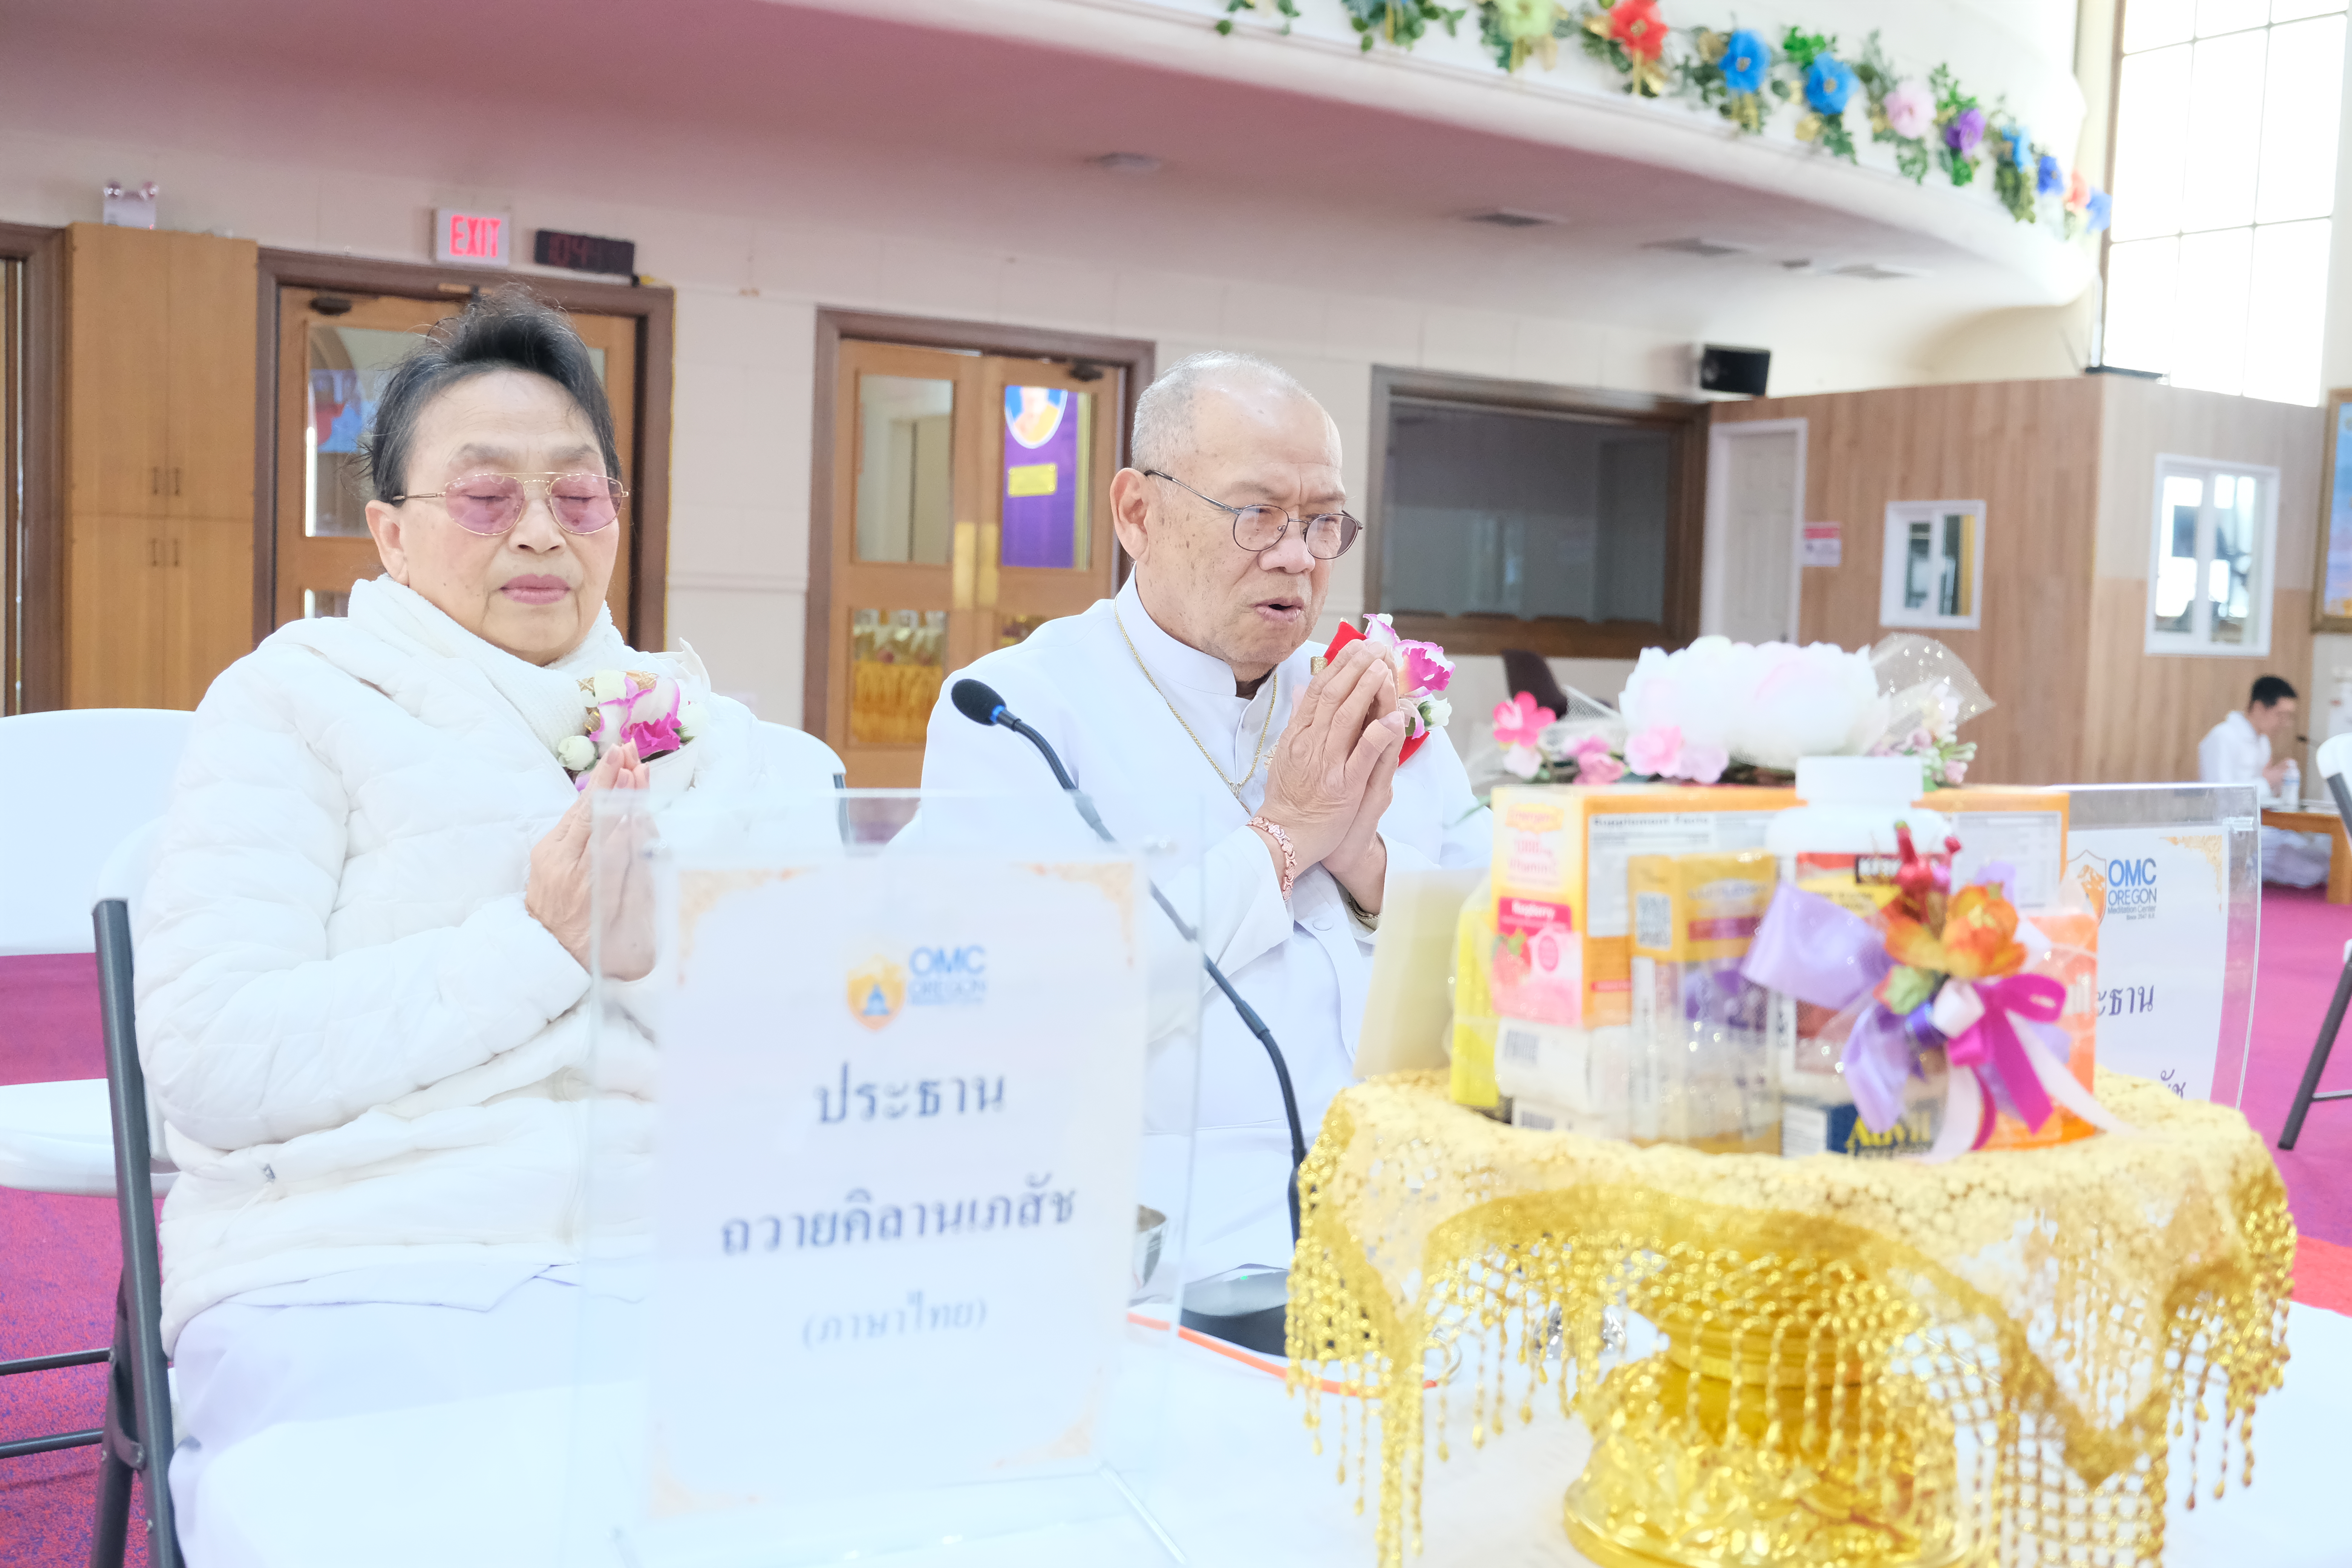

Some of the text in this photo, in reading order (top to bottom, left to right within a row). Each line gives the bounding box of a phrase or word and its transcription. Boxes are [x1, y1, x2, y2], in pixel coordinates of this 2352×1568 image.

[450, 214, 501, 258] EXIT
[2108, 858, 2157, 887] OMC
[2108, 888, 2157, 906] OREGON
[2108, 906, 2137, 914] Meditation
[909, 945, 985, 977] OMC
[2097, 985, 2154, 1017] ะธาน
[813, 1060, 1006, 1125] ประธาน
[802, 1288, 988, 1352] (ภาษาไทย)
